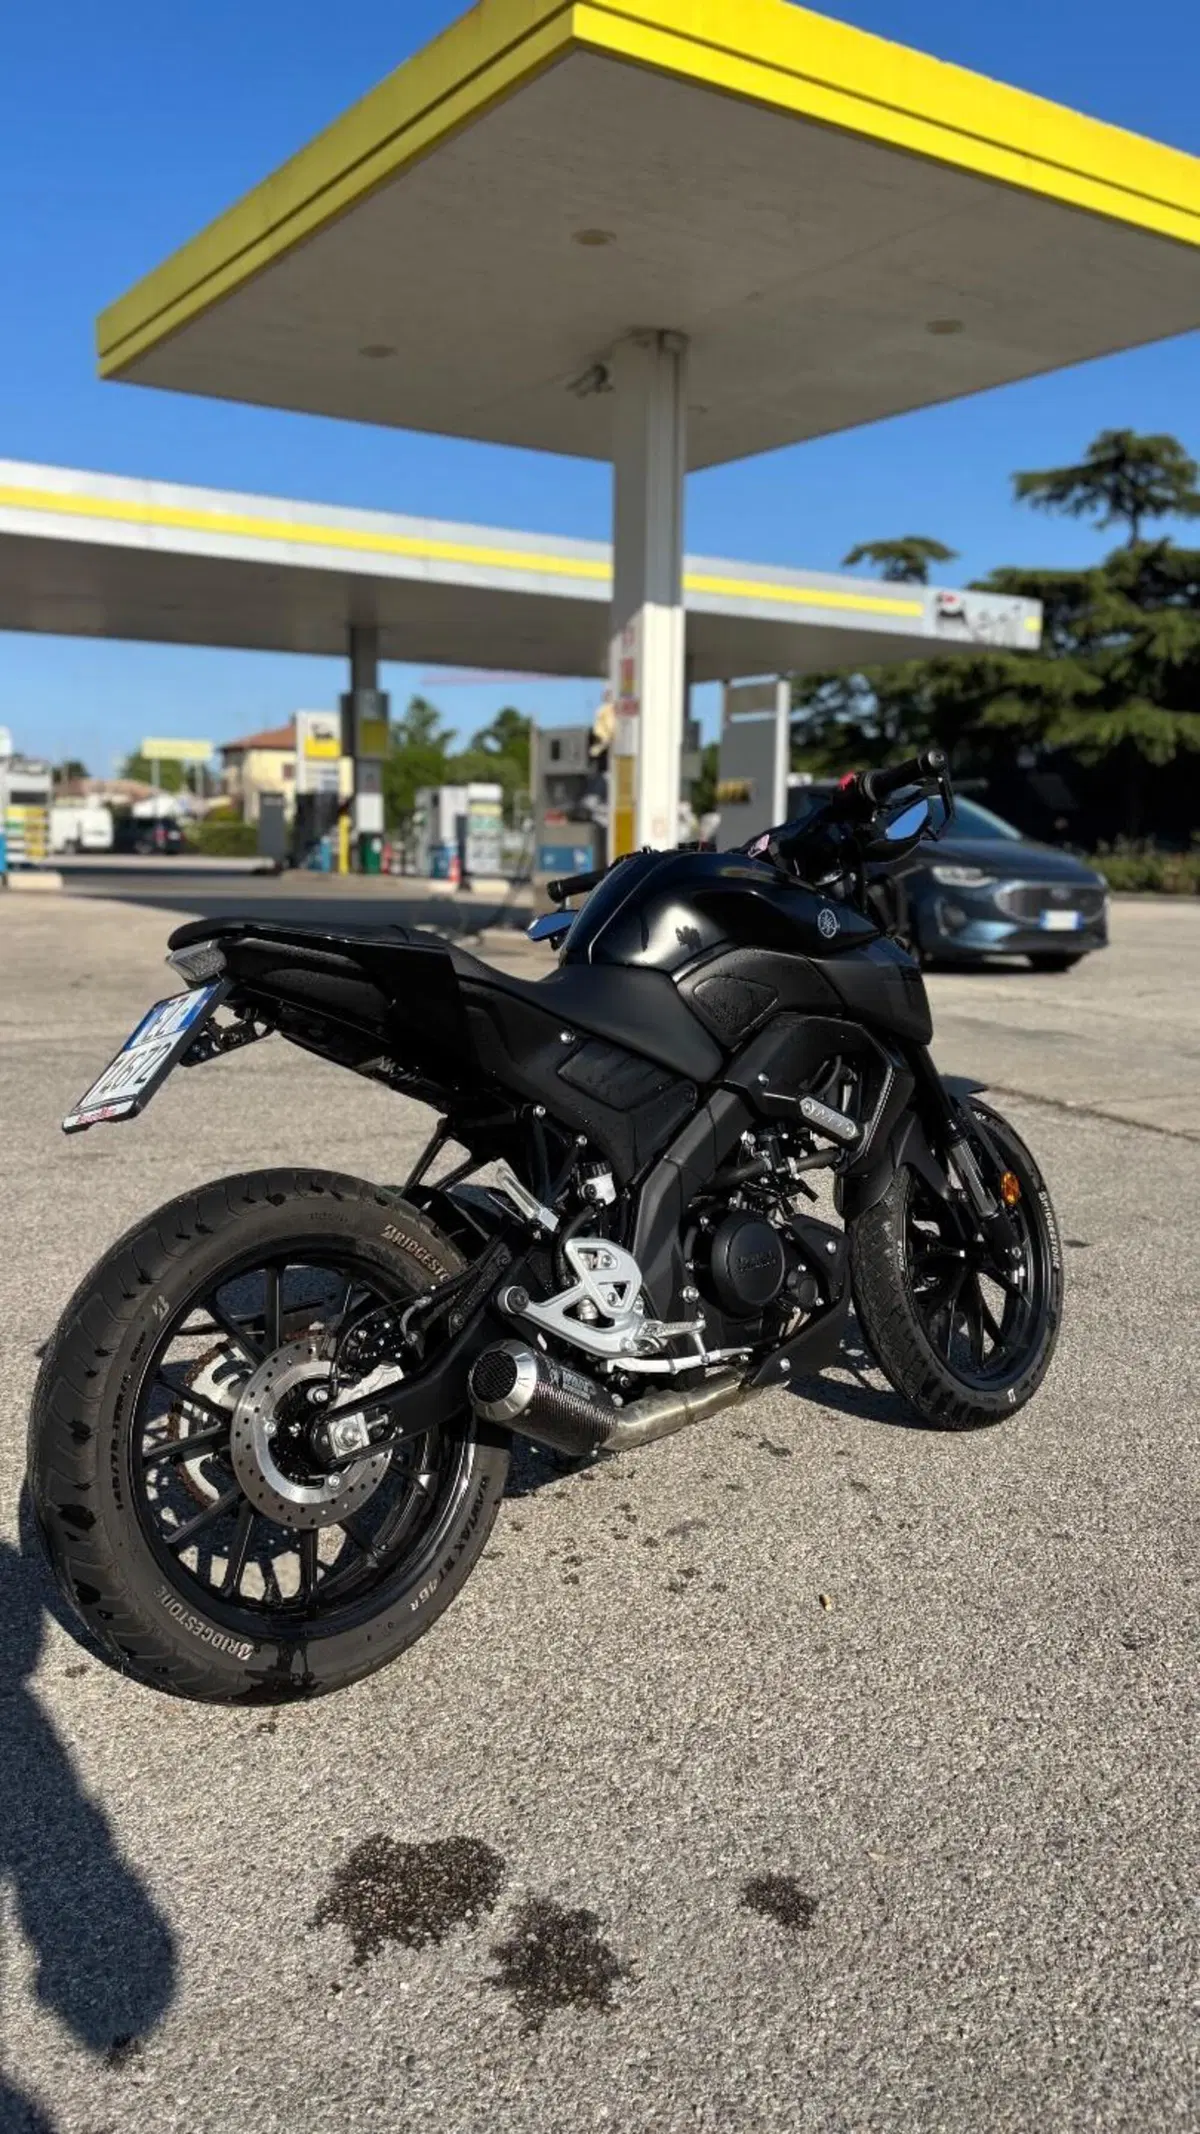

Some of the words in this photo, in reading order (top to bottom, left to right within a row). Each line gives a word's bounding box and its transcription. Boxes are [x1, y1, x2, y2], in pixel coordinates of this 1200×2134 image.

[381, 1224, 452, 1283] BRIDGESTO
[1038, 1191, 1060, 1269] BRIDGESTONE
[154, 1586, 254, 1660] BRIDGESTONE
